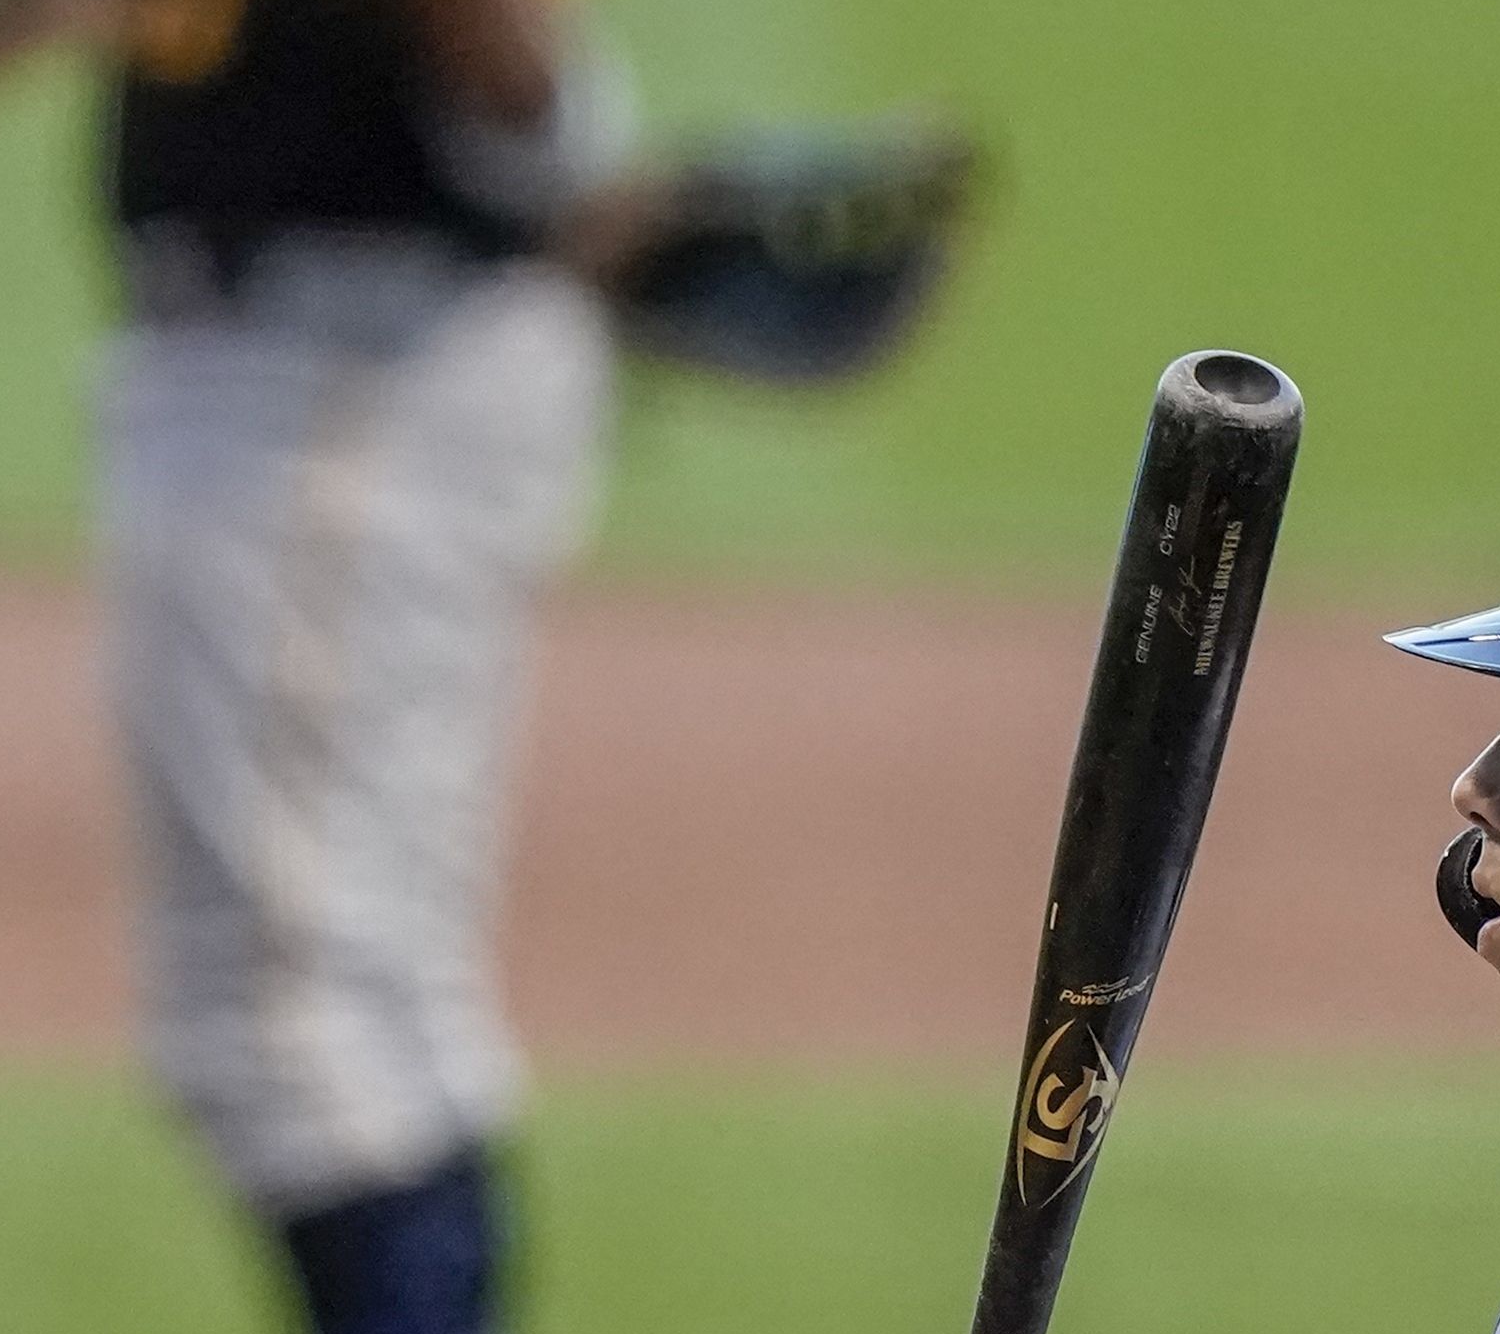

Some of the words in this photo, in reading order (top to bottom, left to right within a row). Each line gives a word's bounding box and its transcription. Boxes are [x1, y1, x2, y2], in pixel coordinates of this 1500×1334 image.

[1136, 584, 1162, 664] GENUINE
[1194, 592, 1228, 675] MILWAUKEE
[1213, 521, 1243, 591] BREWERS
